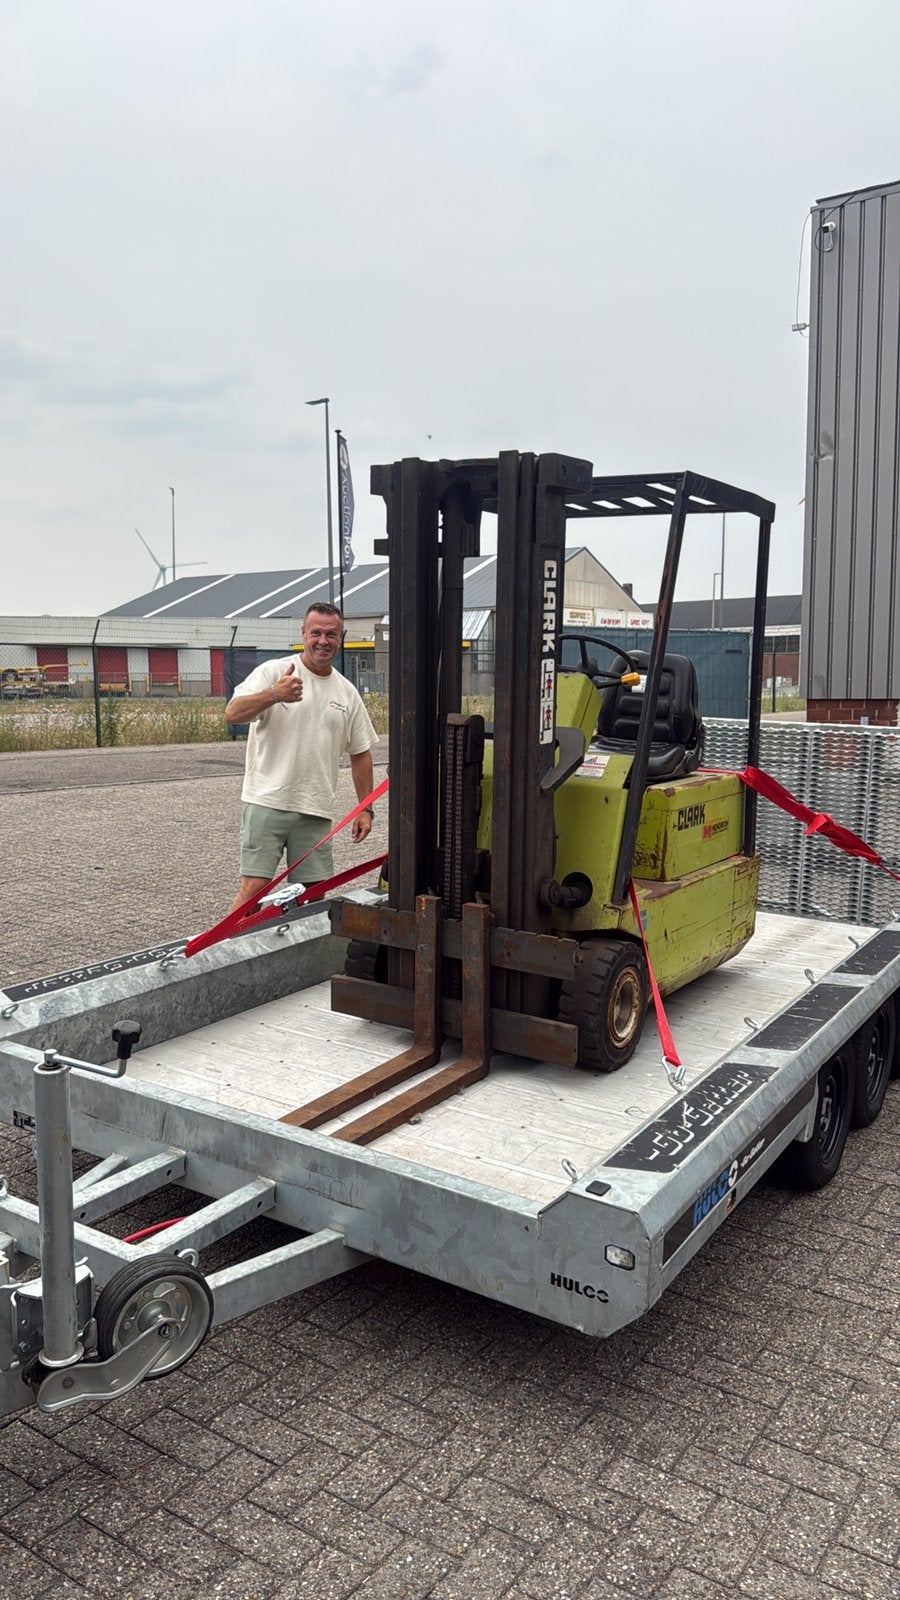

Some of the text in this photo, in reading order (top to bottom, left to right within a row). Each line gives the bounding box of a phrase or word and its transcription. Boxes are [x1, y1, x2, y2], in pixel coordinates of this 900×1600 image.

[542, 560, 557, 653] CLARK
[677, 803, 706, 832] CLARK
[693, 1160, 739, 1230] HULCO
[550, 1271, 609, 1304] HULCO
